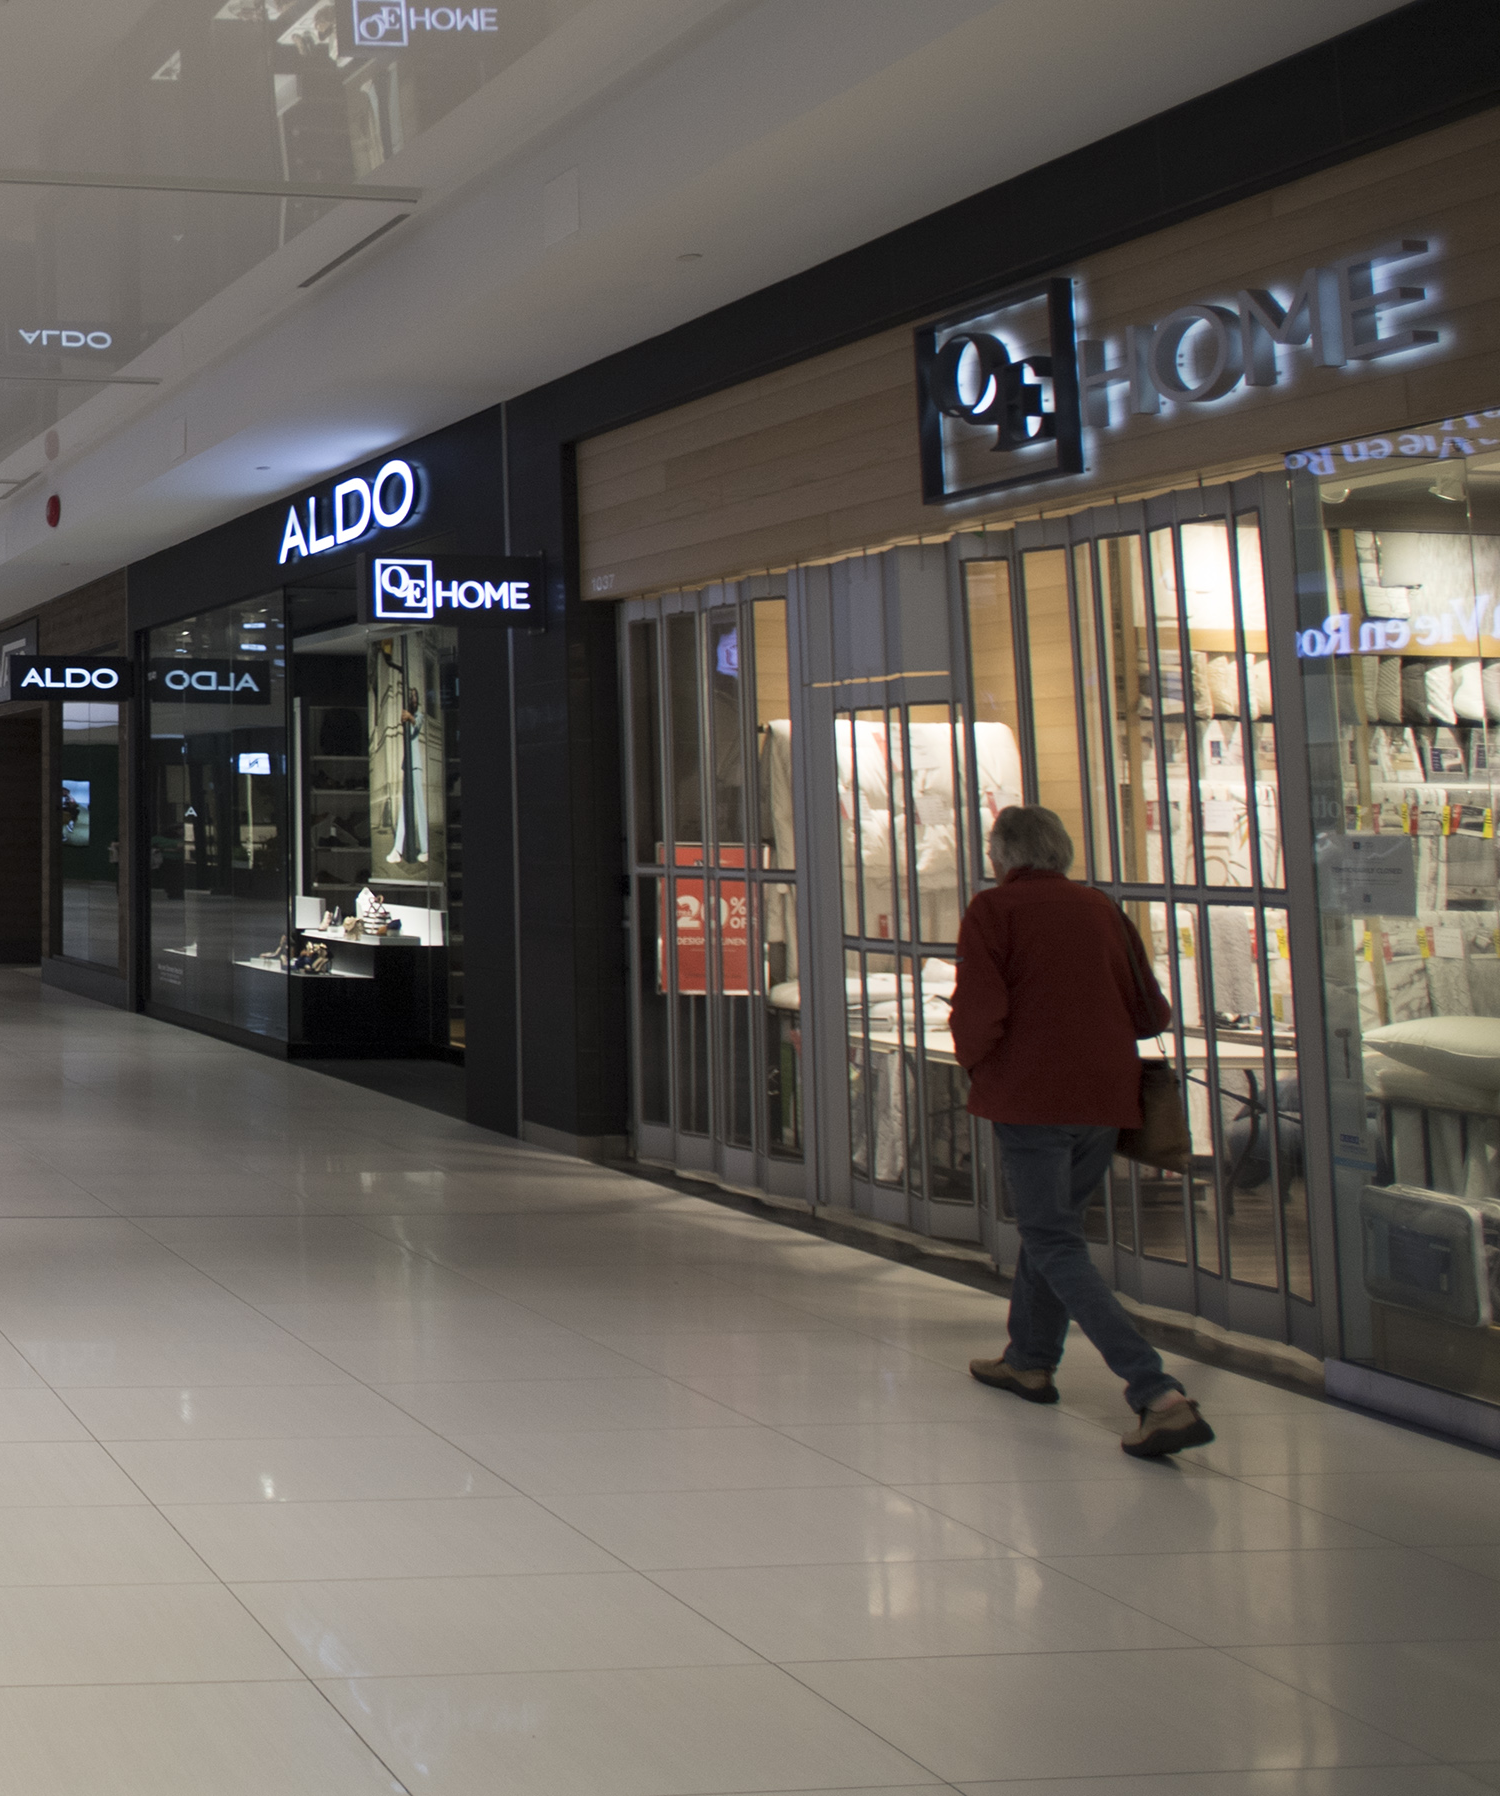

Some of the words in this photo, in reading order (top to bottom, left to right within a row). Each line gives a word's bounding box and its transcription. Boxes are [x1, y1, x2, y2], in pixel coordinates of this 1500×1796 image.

[1077, 240, 1440, 427] HOME
[279, 459, 414, 565] ALDO
[435, 580, 531, 610] HOME
[20, 667, 119, 689] ALDO
